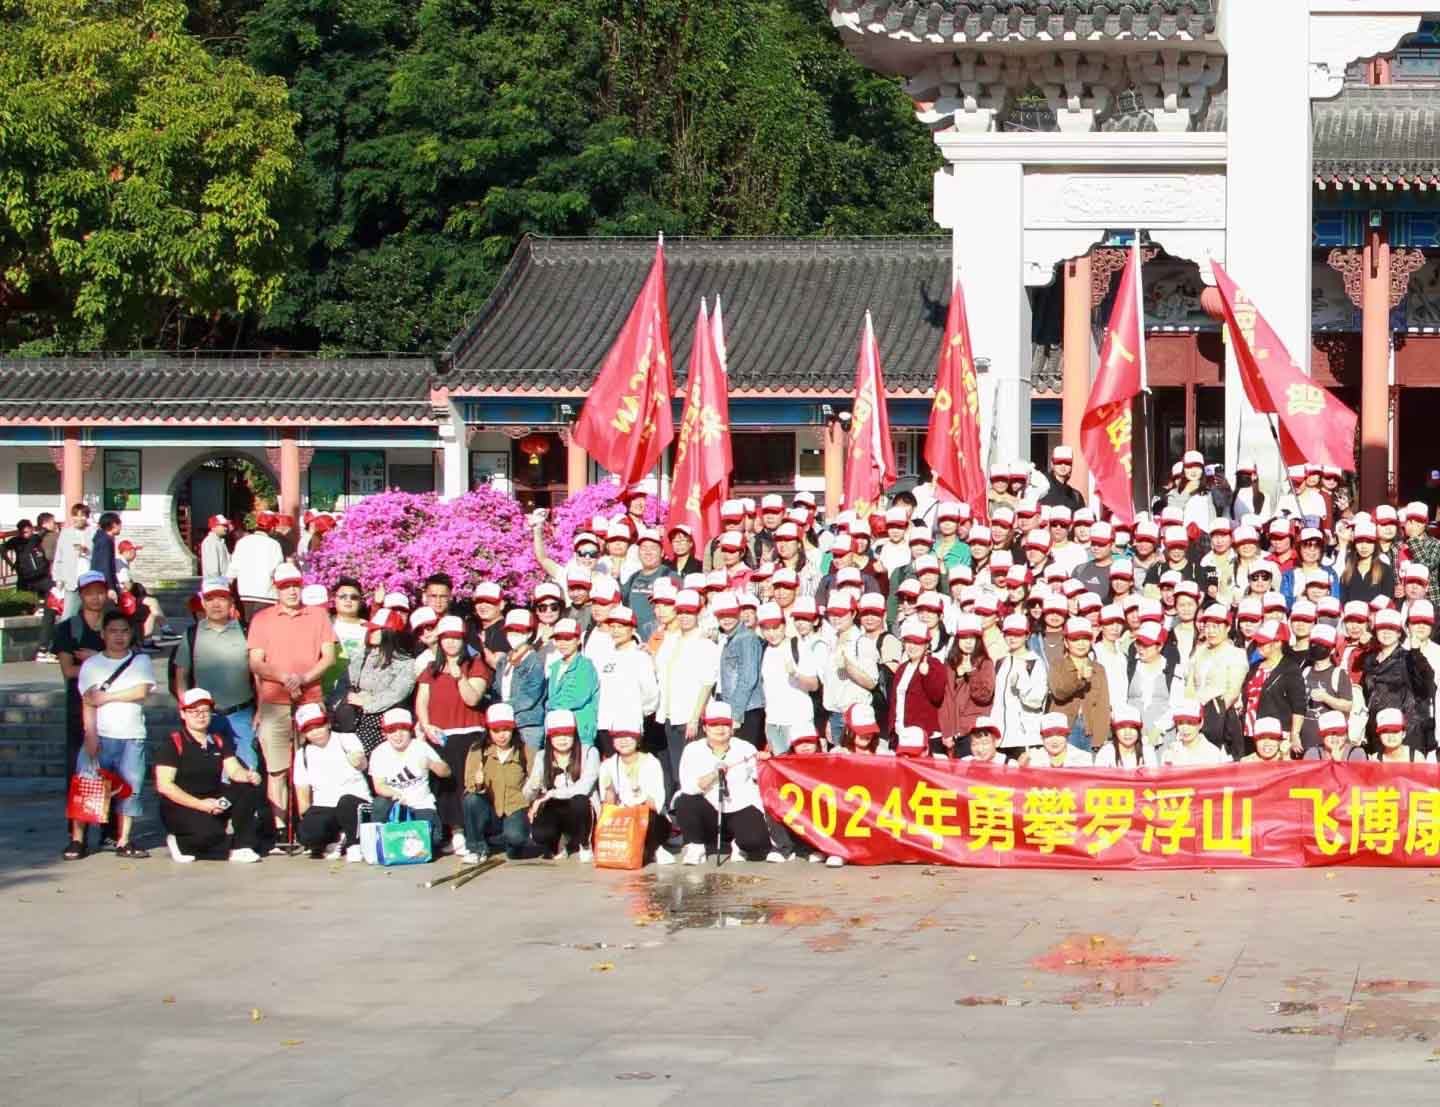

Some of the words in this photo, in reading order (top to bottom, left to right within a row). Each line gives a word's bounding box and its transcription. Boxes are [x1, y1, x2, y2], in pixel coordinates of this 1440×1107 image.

[779, 783, 1252, 855] 2024年勇攀罗浮山
